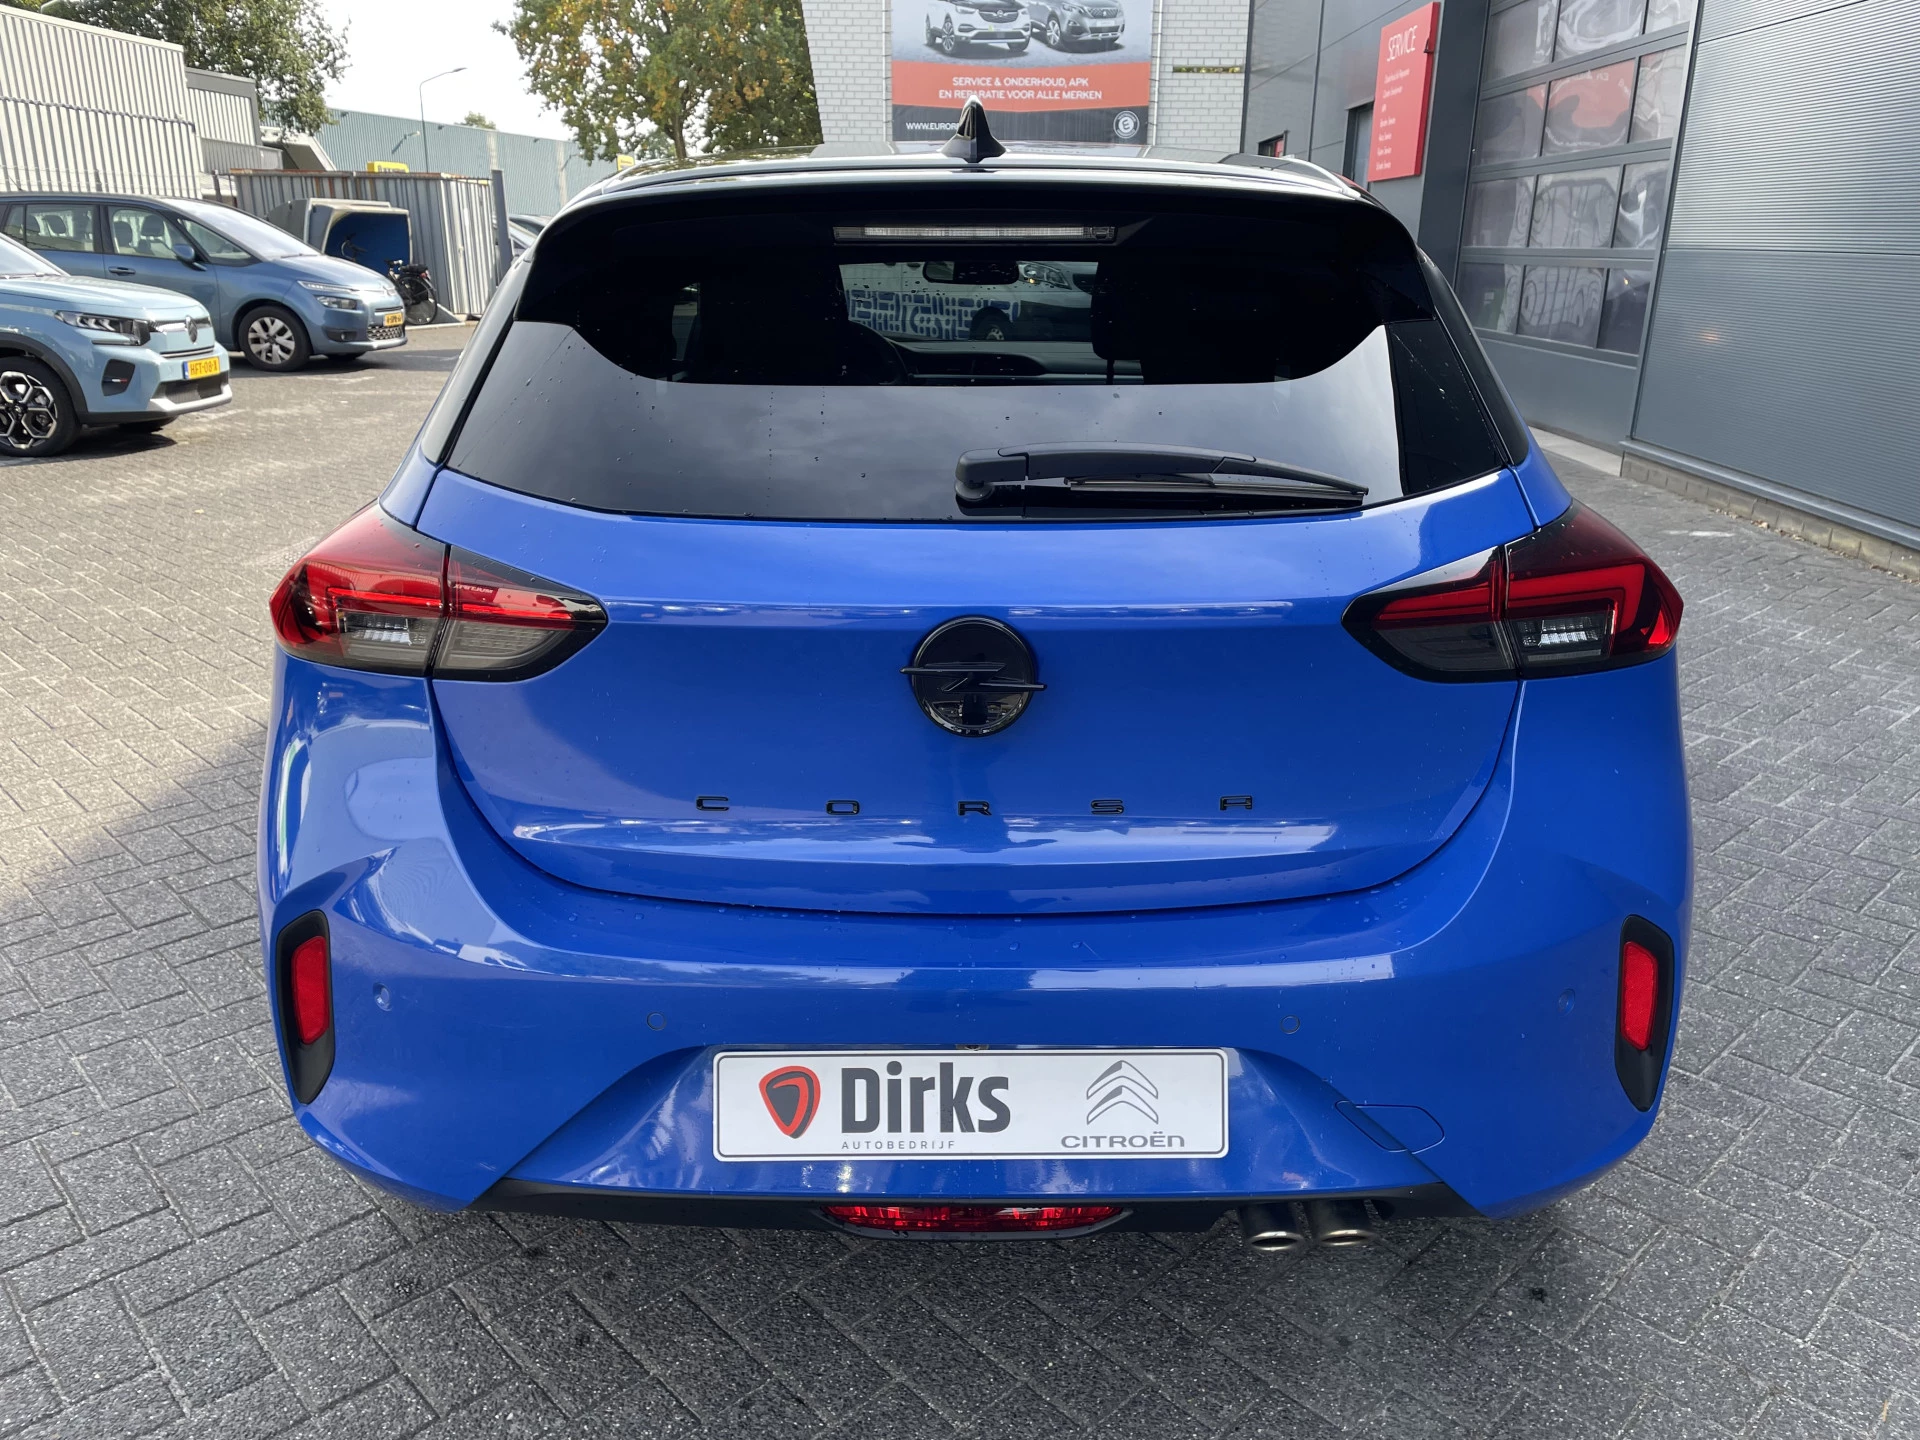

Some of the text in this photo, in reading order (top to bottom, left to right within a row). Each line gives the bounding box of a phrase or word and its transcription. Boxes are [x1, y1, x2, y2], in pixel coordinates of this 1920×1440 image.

[1386, 25, 1418, 62] SERVICE
[952, 76, 1089, 88] SERVICE & ONDERHOUD, APK
[939, 90, 952, 99] EN
[1006, 90, 1035, 99] VOOR
[1036, 90, 1060, 99] ALLE
[1062, 90, 1102, 99] MERKEN
[695, 794, 1254, 817] CORSA
[841, 1060, 1011, 1133] Dirks
[841, 1140, 955, 1150] AUTOBEDRIJF
